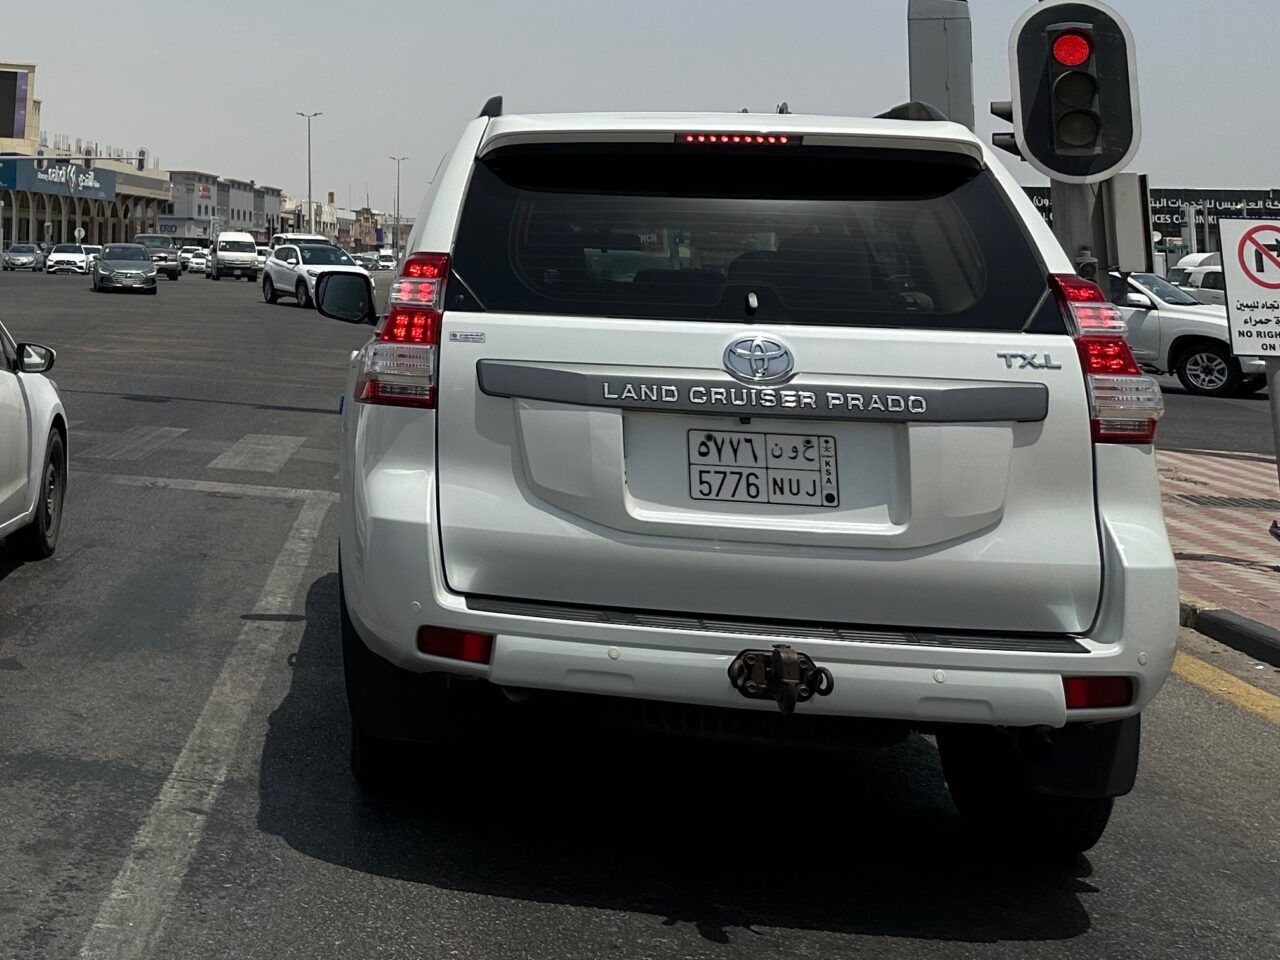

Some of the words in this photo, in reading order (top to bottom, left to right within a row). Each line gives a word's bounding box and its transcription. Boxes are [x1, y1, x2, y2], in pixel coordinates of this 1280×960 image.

[1236, 300, 1260, 312] لليمين
[1243, 316, 1273, 327] حمراء
[1238, 330, 1253, 339] NO
[1261, 343, 1277, 351] ON
[603, 382, 679, 402] LAND
[689, 386, 817, 409] CRUISER
[826, 392, 927, 414] PRADO
[824, 460, 833, 485] KSA
[699, 470, 760, 499] 5776
[772, 477, 817, 497] NUJ
